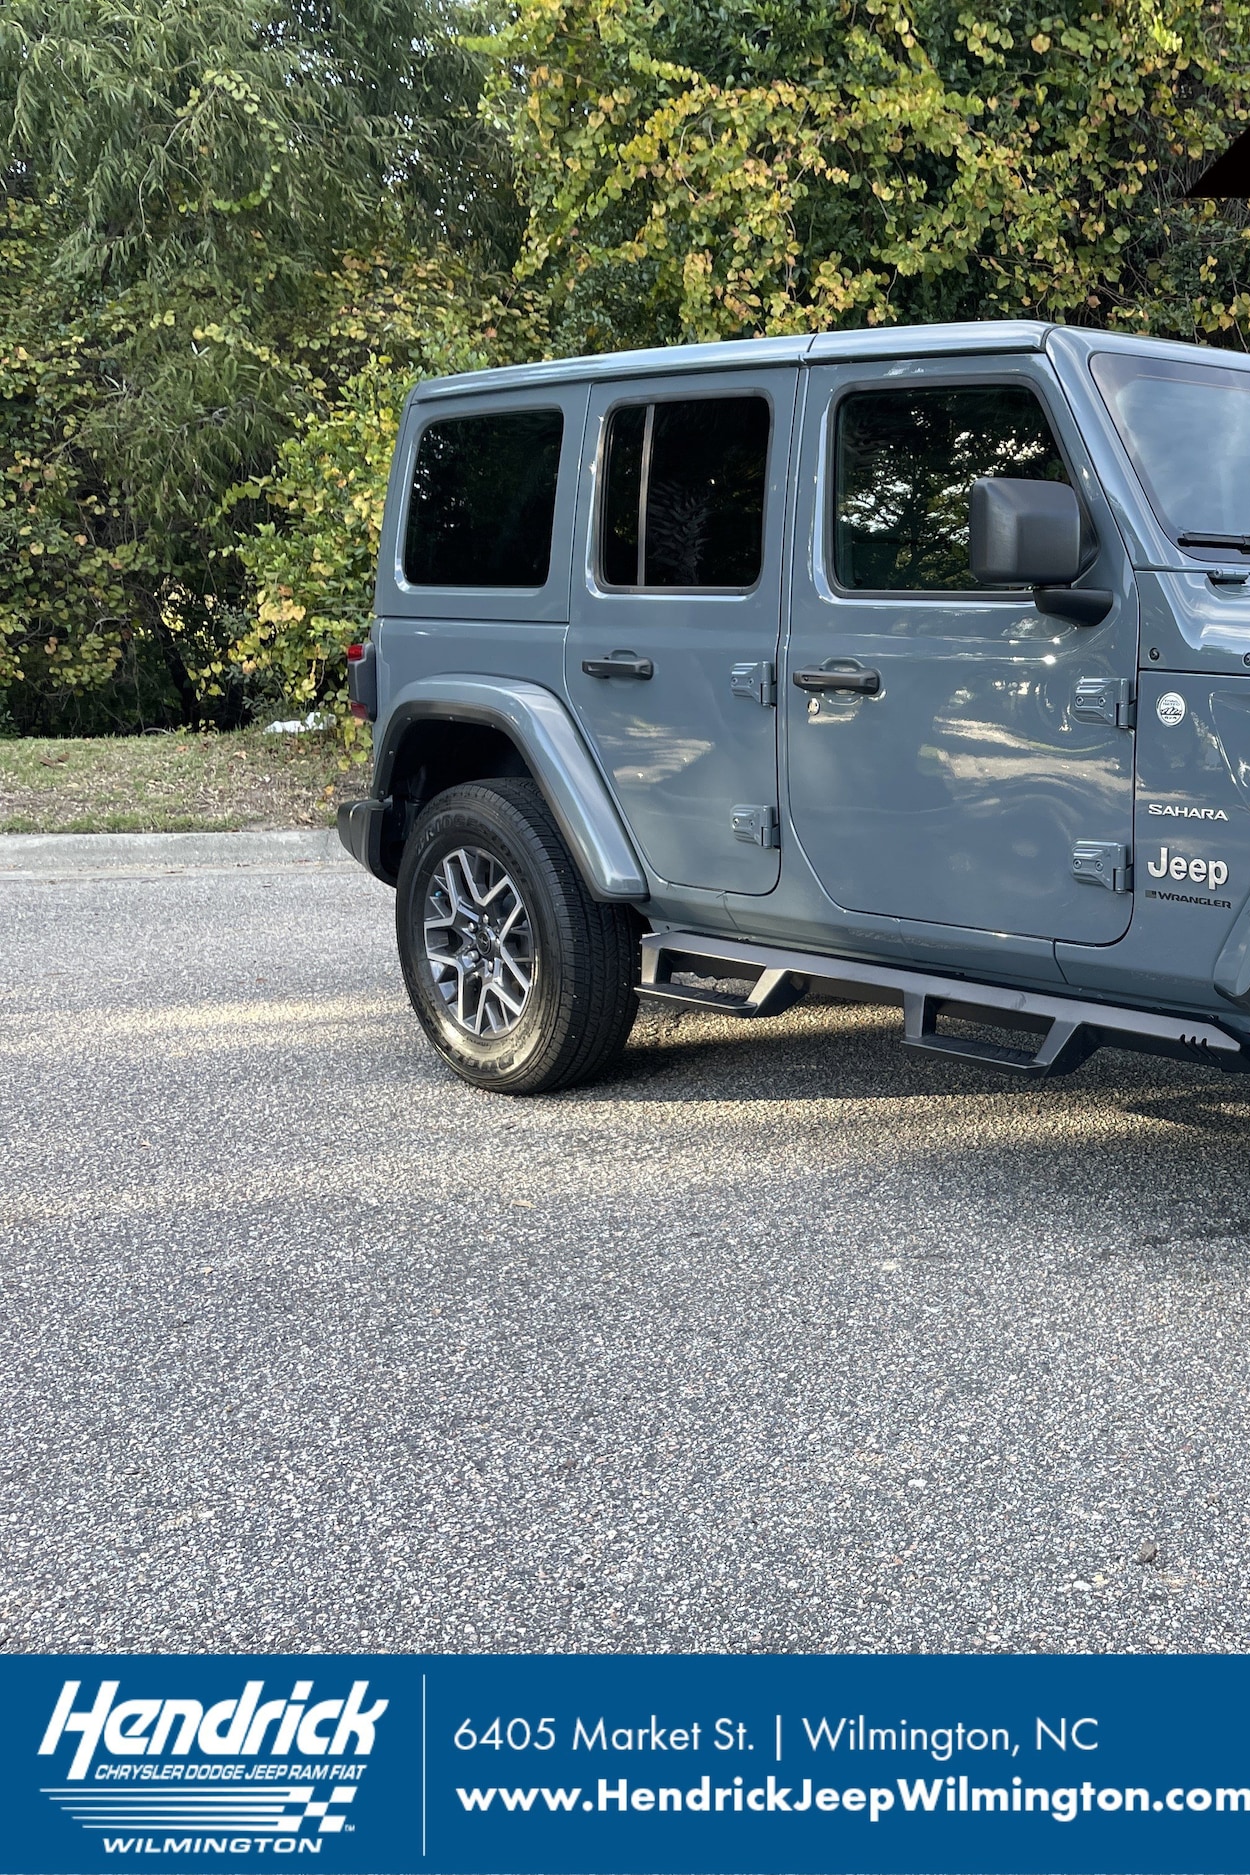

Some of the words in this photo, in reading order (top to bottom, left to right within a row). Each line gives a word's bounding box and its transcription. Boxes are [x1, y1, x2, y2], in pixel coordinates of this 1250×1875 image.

[1148, 803, 1229, 821] SAHARA
[1147, 847, 1229, 890] Jeep
[1157, 891, 1232, 909] WRANGLER
